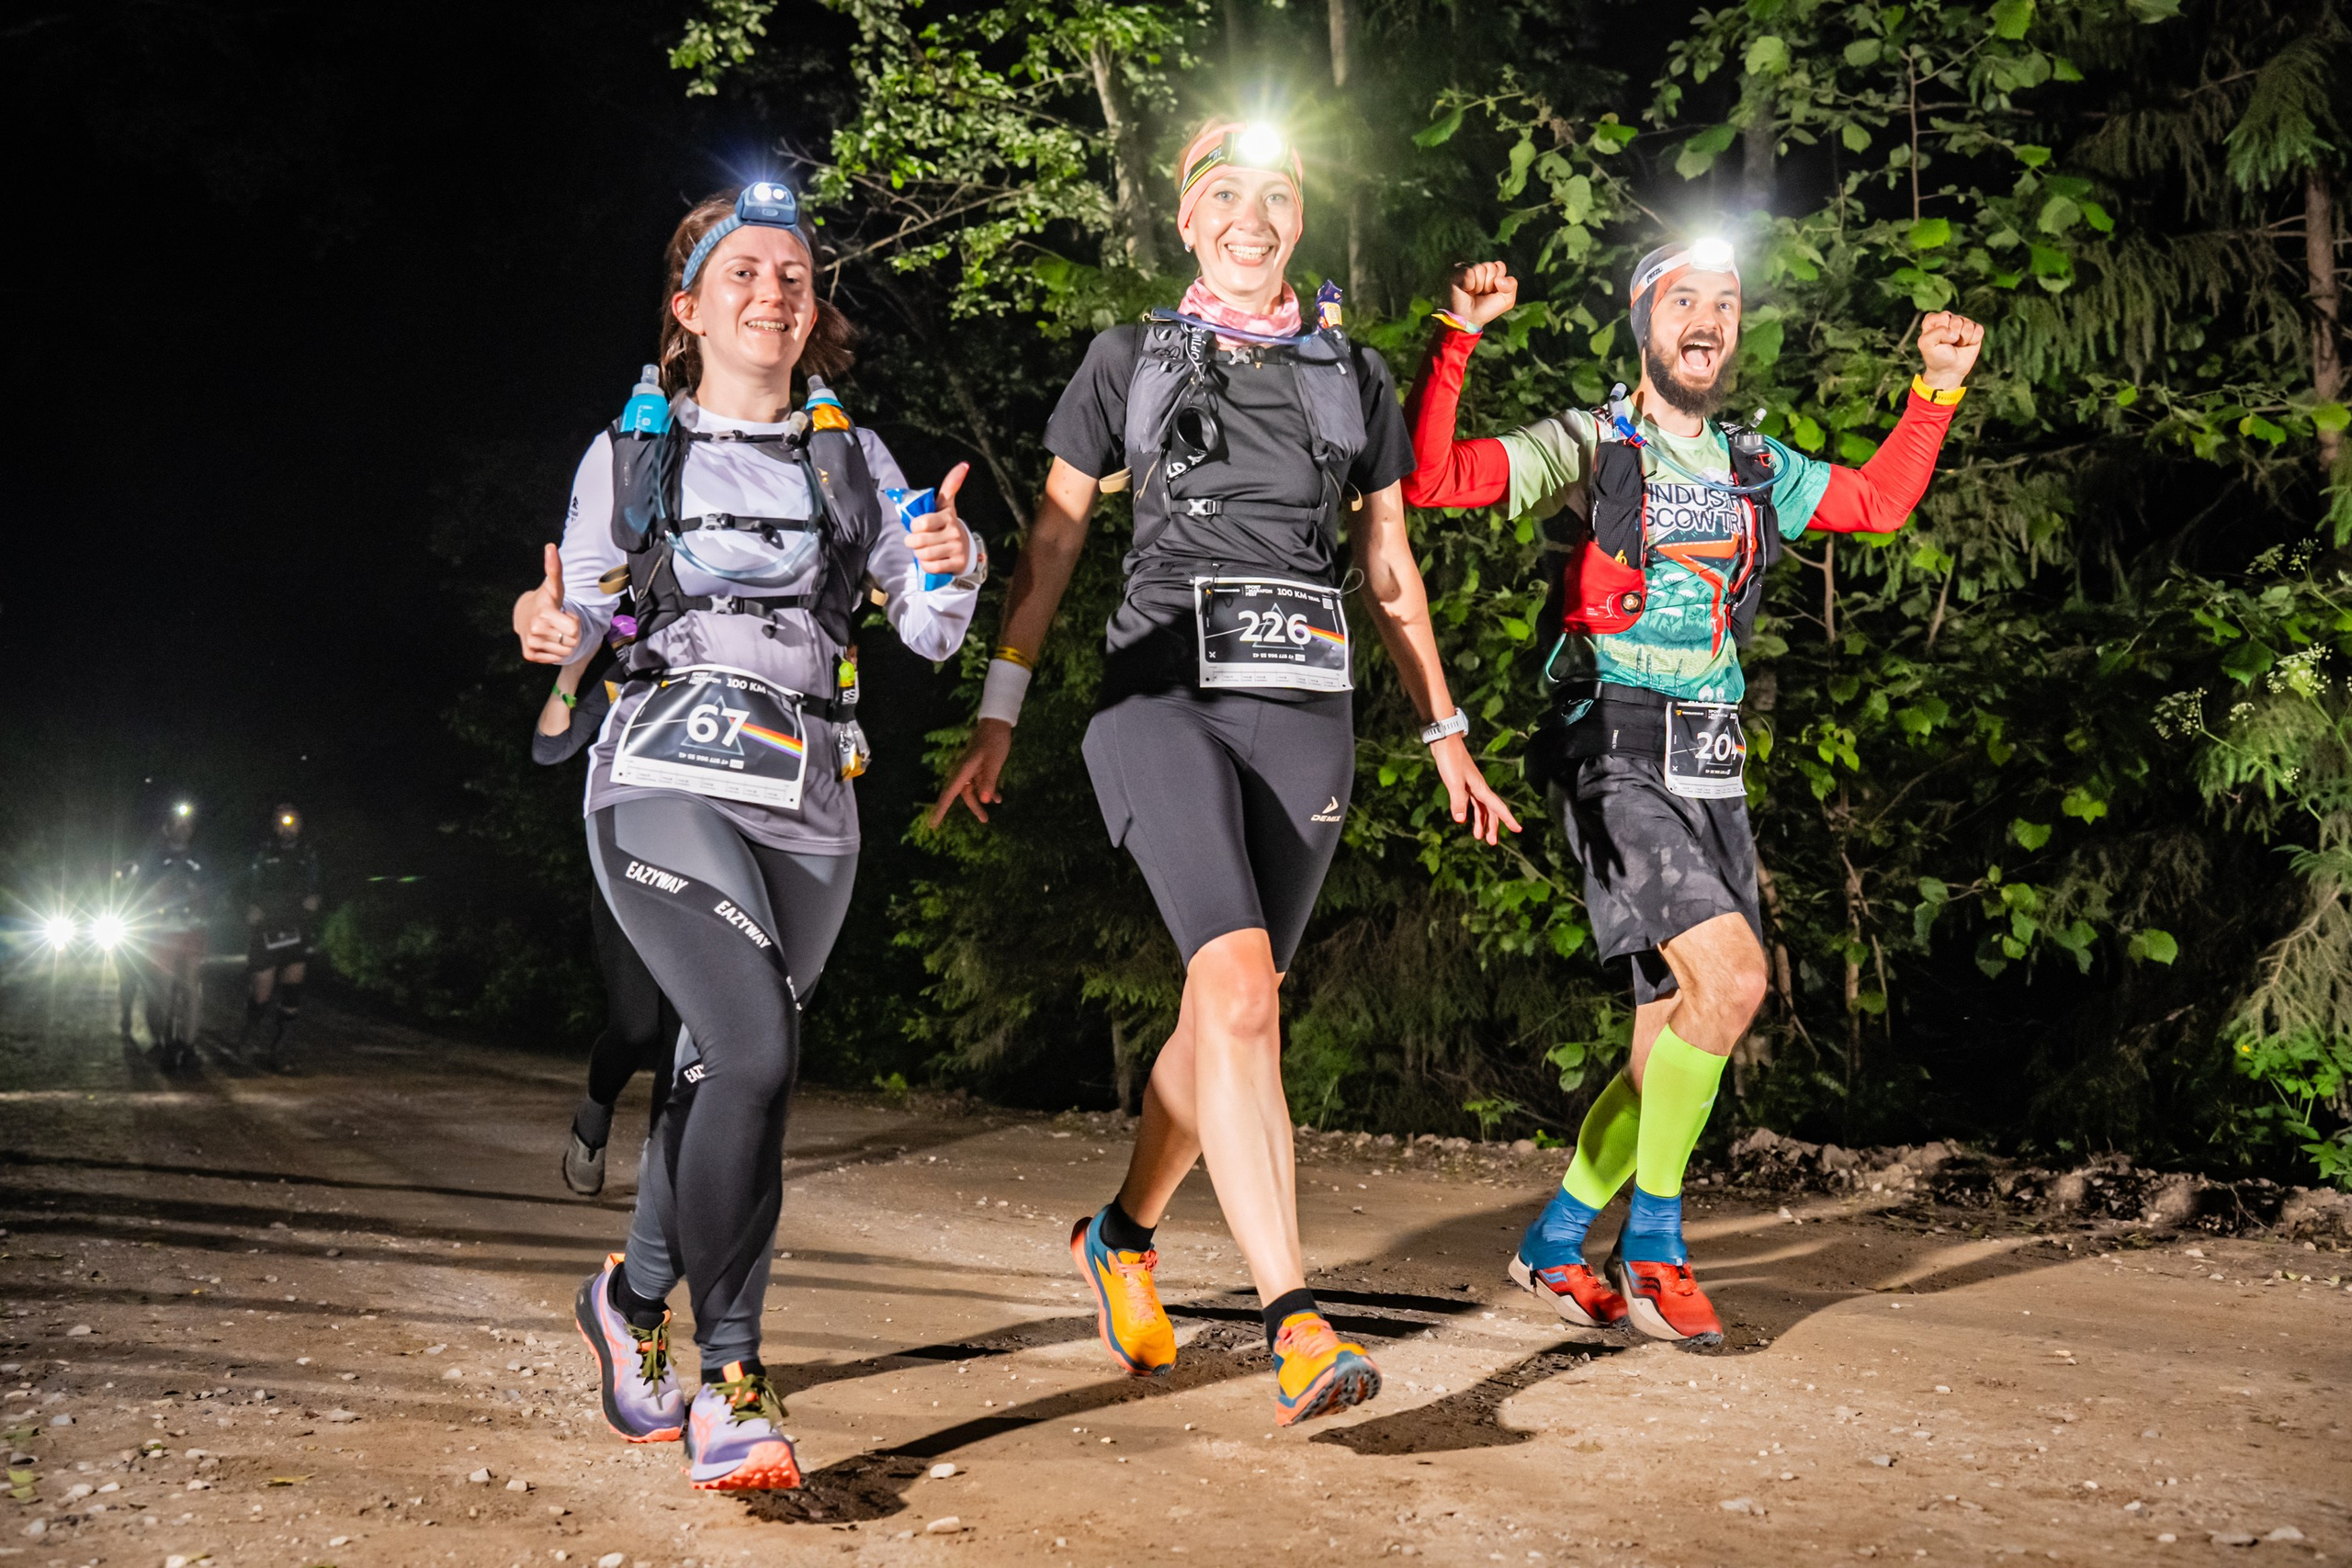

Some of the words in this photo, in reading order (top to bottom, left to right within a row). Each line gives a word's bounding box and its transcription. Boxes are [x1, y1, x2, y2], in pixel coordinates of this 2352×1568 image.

[1277, 588, 1293, 597] 100
[1295, 590, 1307, 600] KM
[1238, 610, 1312, 645] 226
[727, 678, 748, 690] 100
[749, 682, 767, 694] KM
[686, 704, 751, 748] 67
[625, 860, 689, 895] EAZYWAY
[713, 899, 772, 949] EAZYWAY
